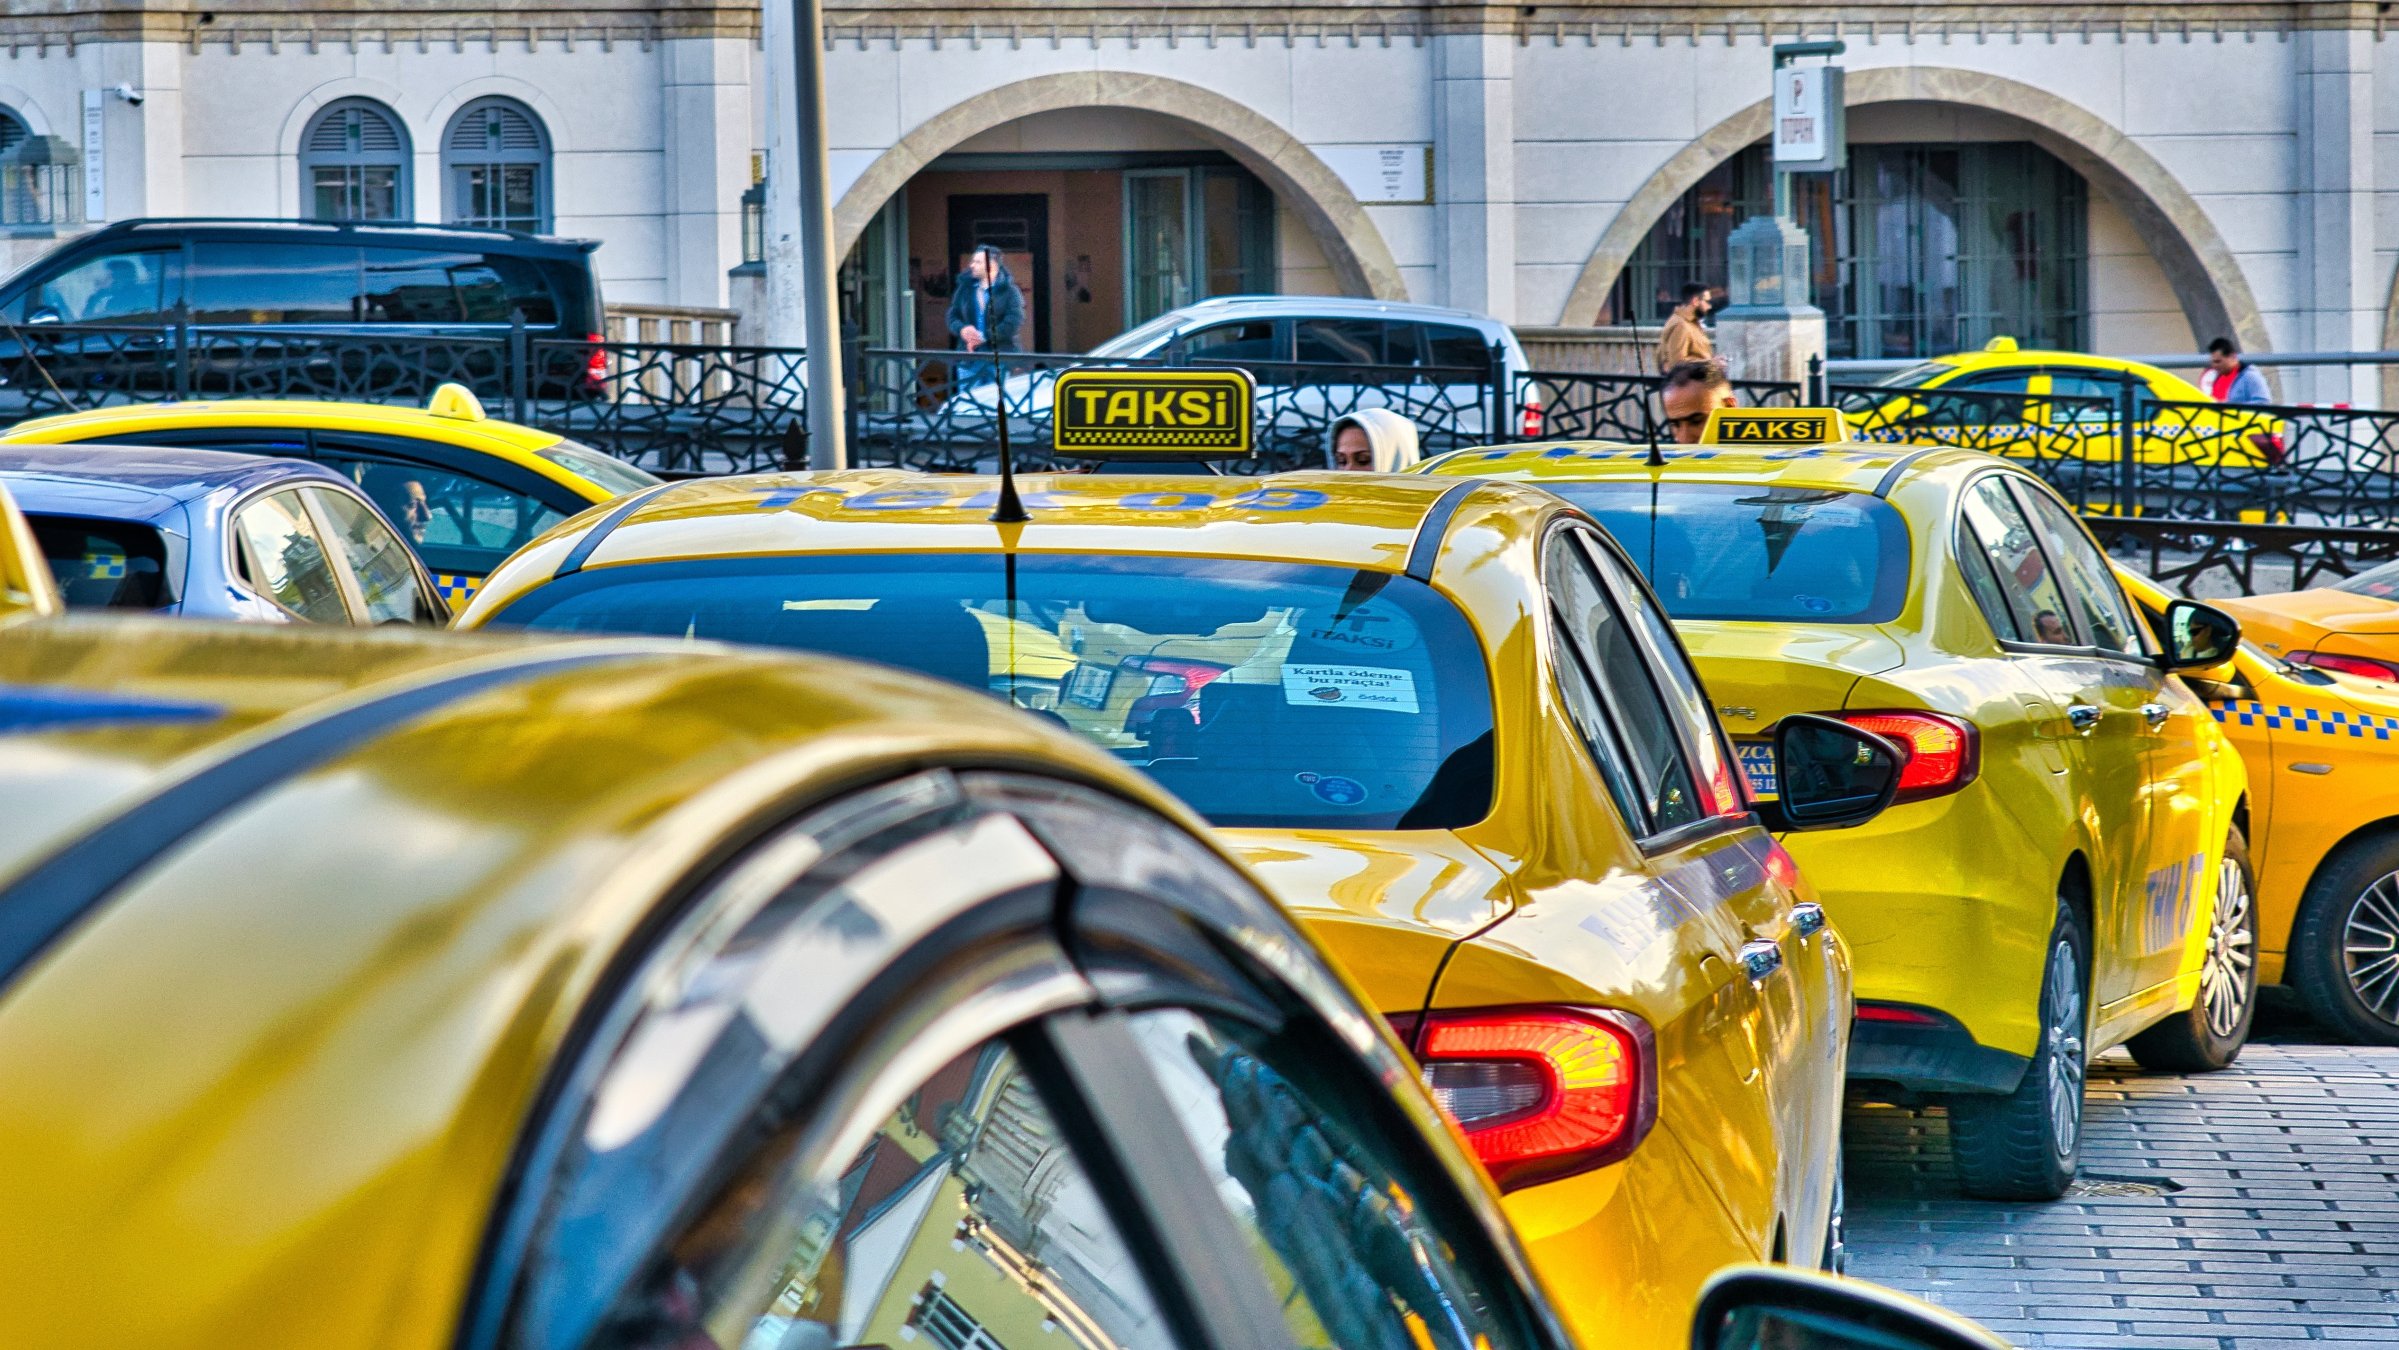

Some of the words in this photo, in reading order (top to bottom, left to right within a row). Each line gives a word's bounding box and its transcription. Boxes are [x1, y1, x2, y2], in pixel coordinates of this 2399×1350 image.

[1074, 390, 1227, 426] TAKSi
[1721, 421, 1823, 439] TAKSi
[1292, 668, 1344, 677] Kartla
[1348, 669, 1403, 680] ödeme
[1308, 676, 1329, 684] bu
